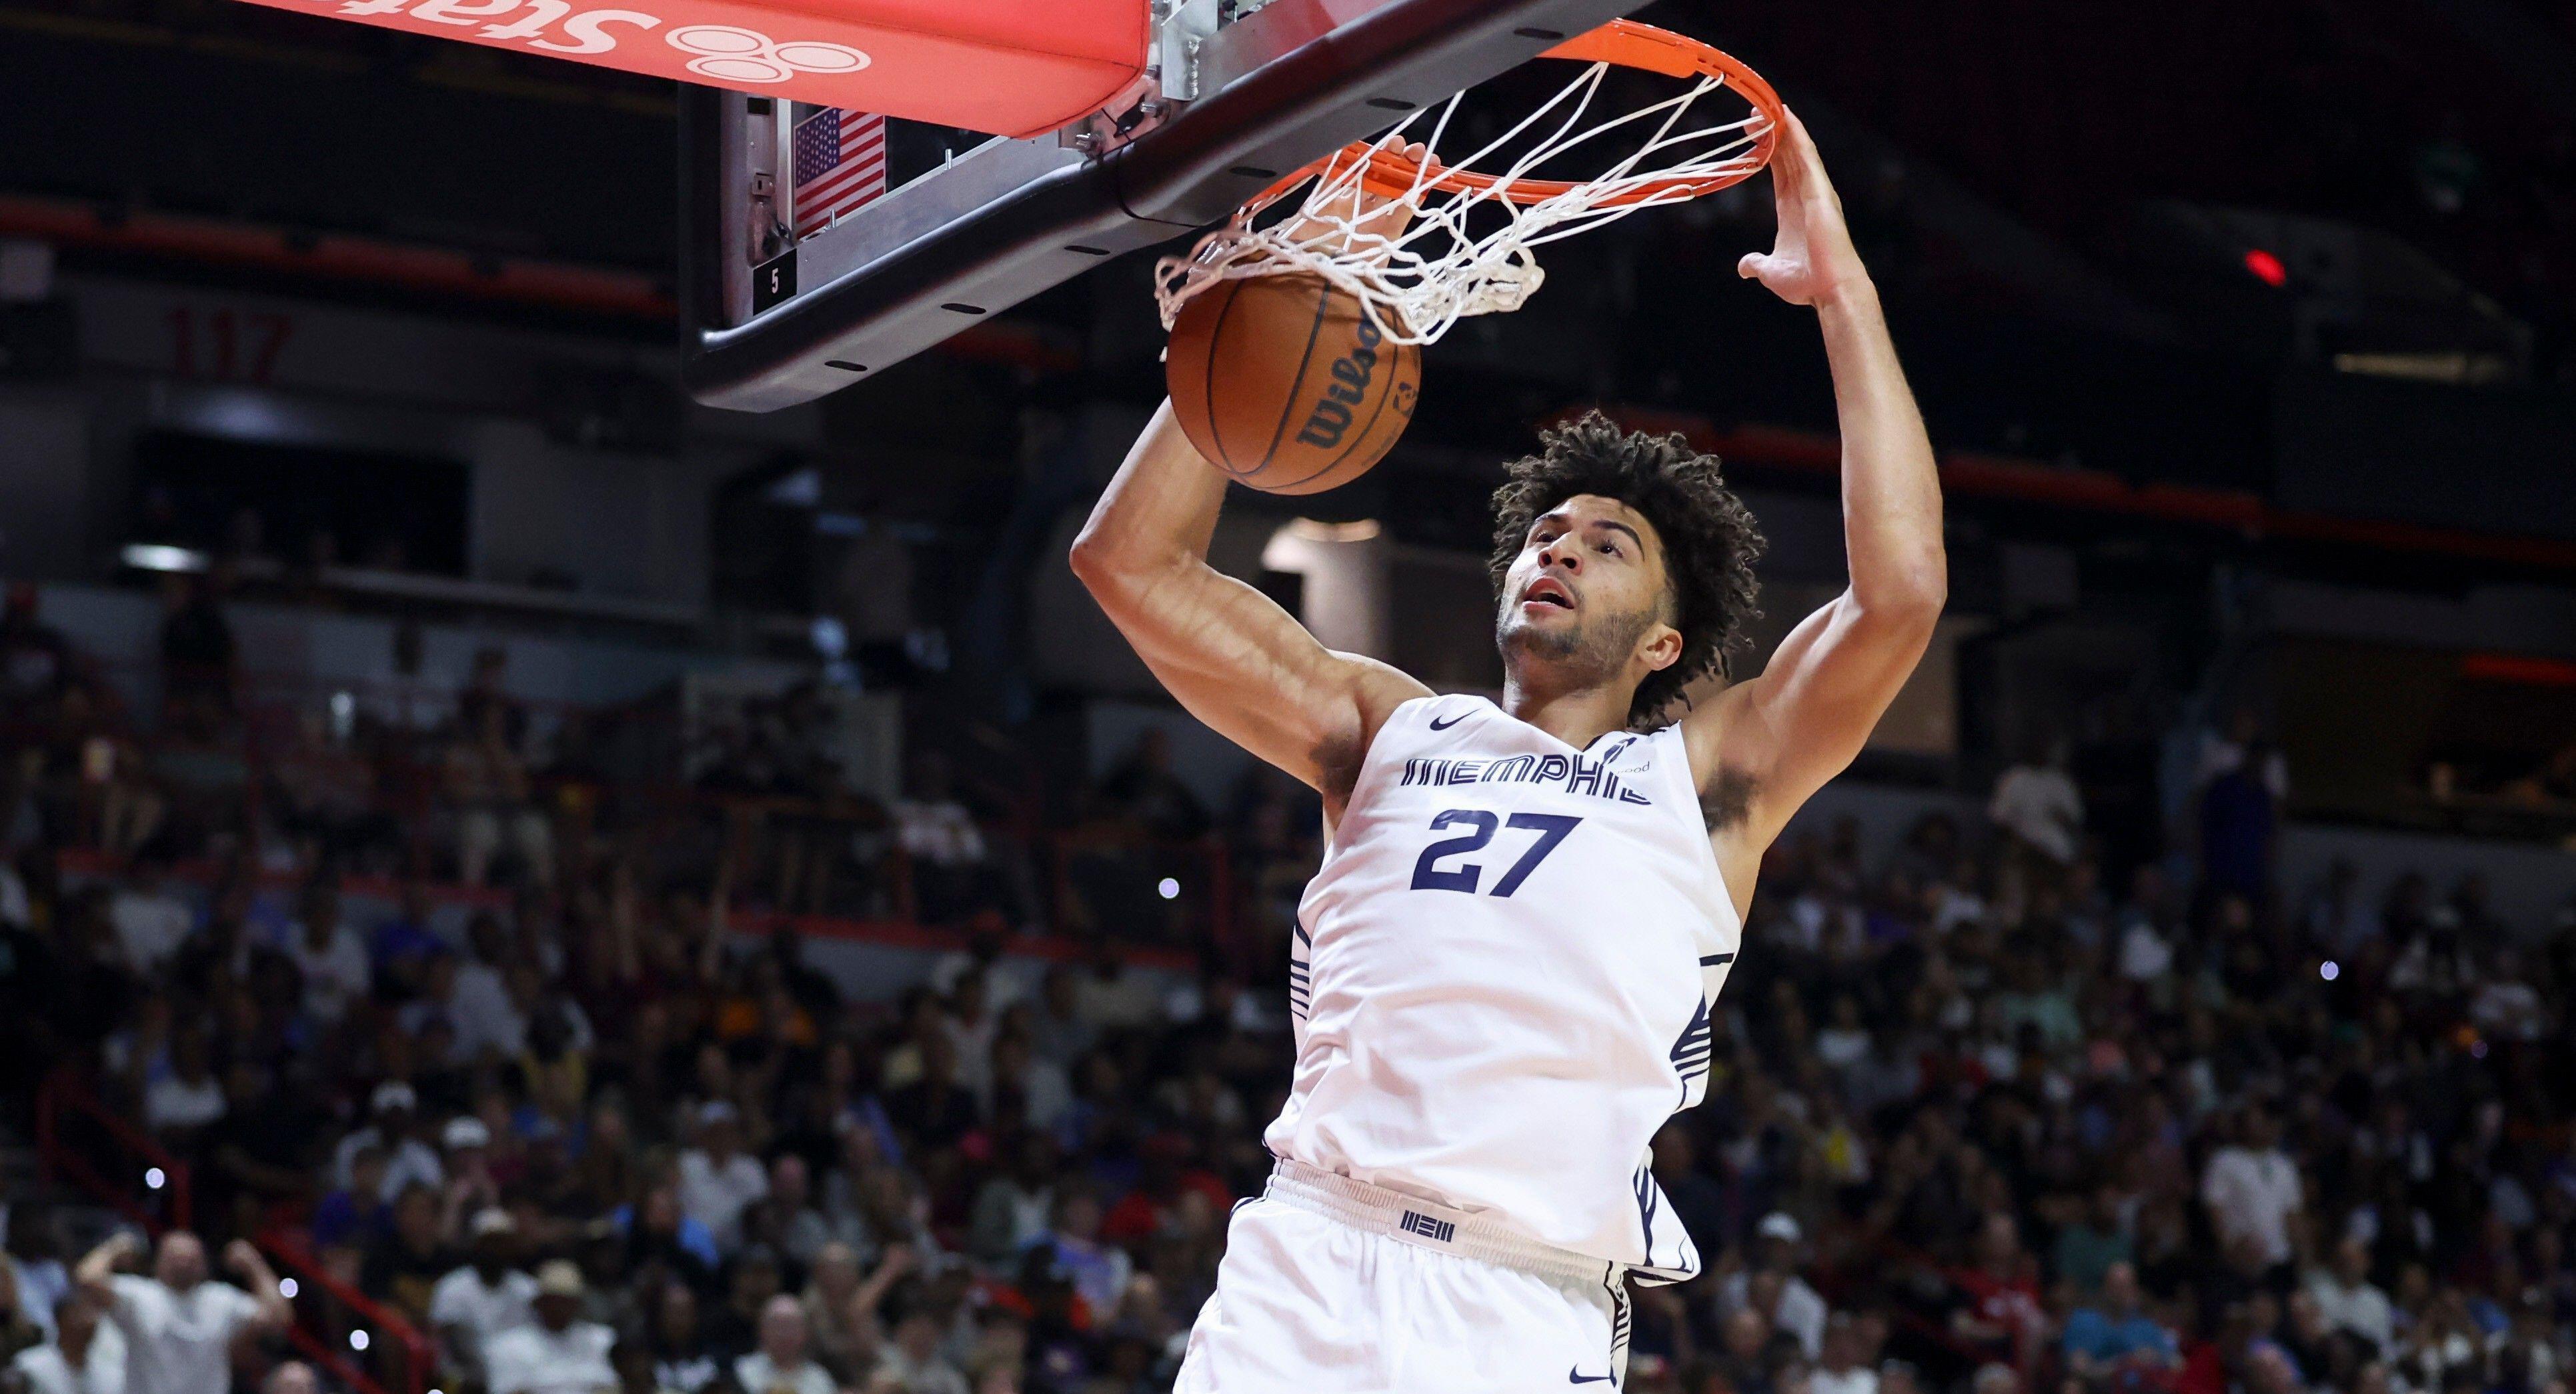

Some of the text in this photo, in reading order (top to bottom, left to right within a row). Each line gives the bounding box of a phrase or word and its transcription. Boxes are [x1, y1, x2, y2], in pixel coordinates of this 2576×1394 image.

[772, 267, 779, 293] 5
[165, 307, 293, 383] 117
[1410, 809, 1584, 898] 27
